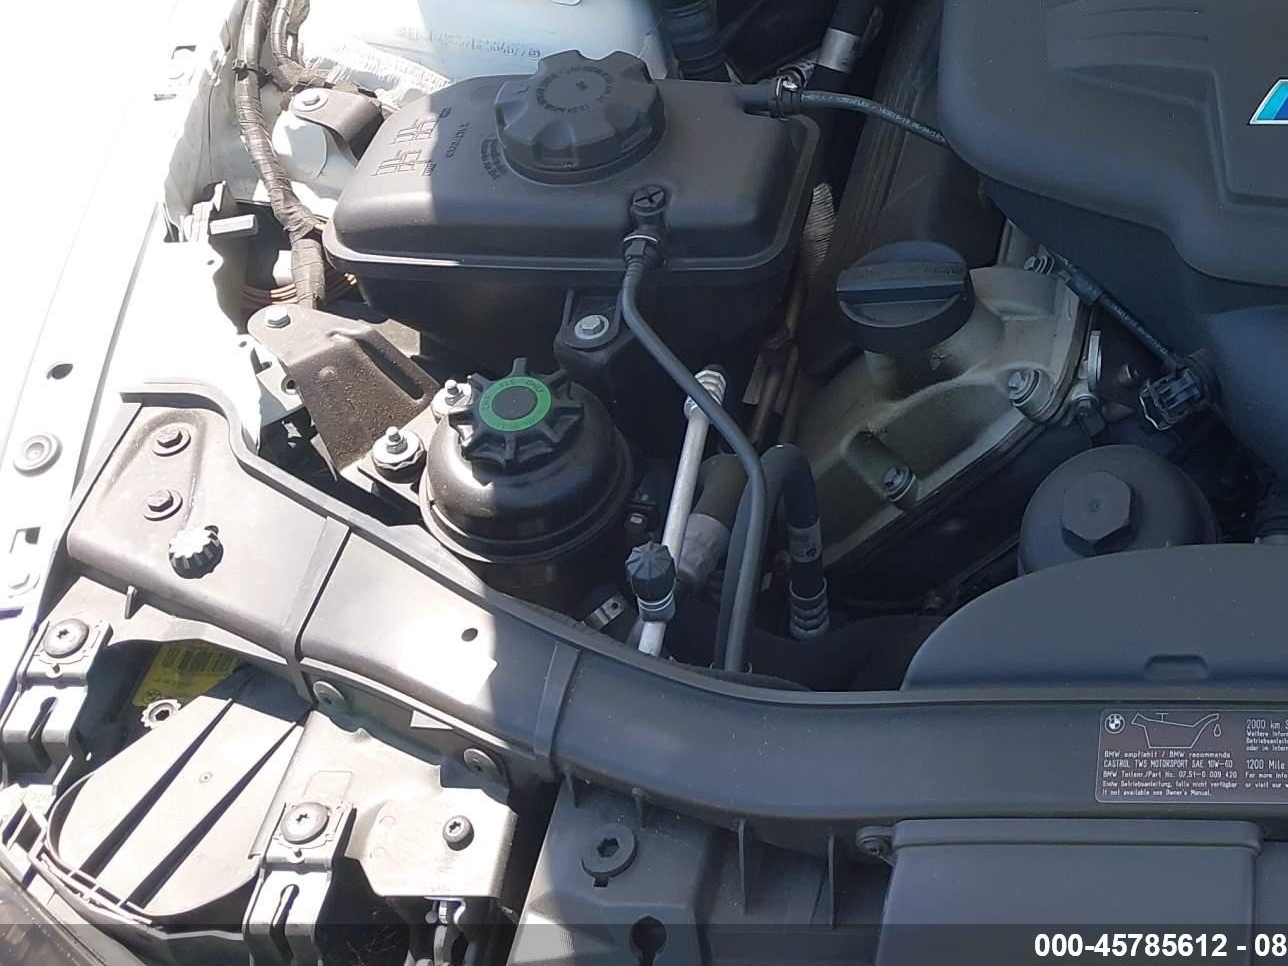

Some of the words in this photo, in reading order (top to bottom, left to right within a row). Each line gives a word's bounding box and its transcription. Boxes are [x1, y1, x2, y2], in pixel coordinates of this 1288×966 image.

[1246, 720, 1265, 730] 2000
[1270, 720, 1280, 730] km
[1104, 760, 1130, 768] CASTROL
[1135, 760, 1147, 768] TWS
[1151, 760, 1188, 768] MOTORSPORT
[1192, 760, 1203, 768] SAE
[1208, 760, 1232, 768] 10W-60
[1246, 760, 1263, 770] 1200
[1269, 760, 1284, 770] Mile
